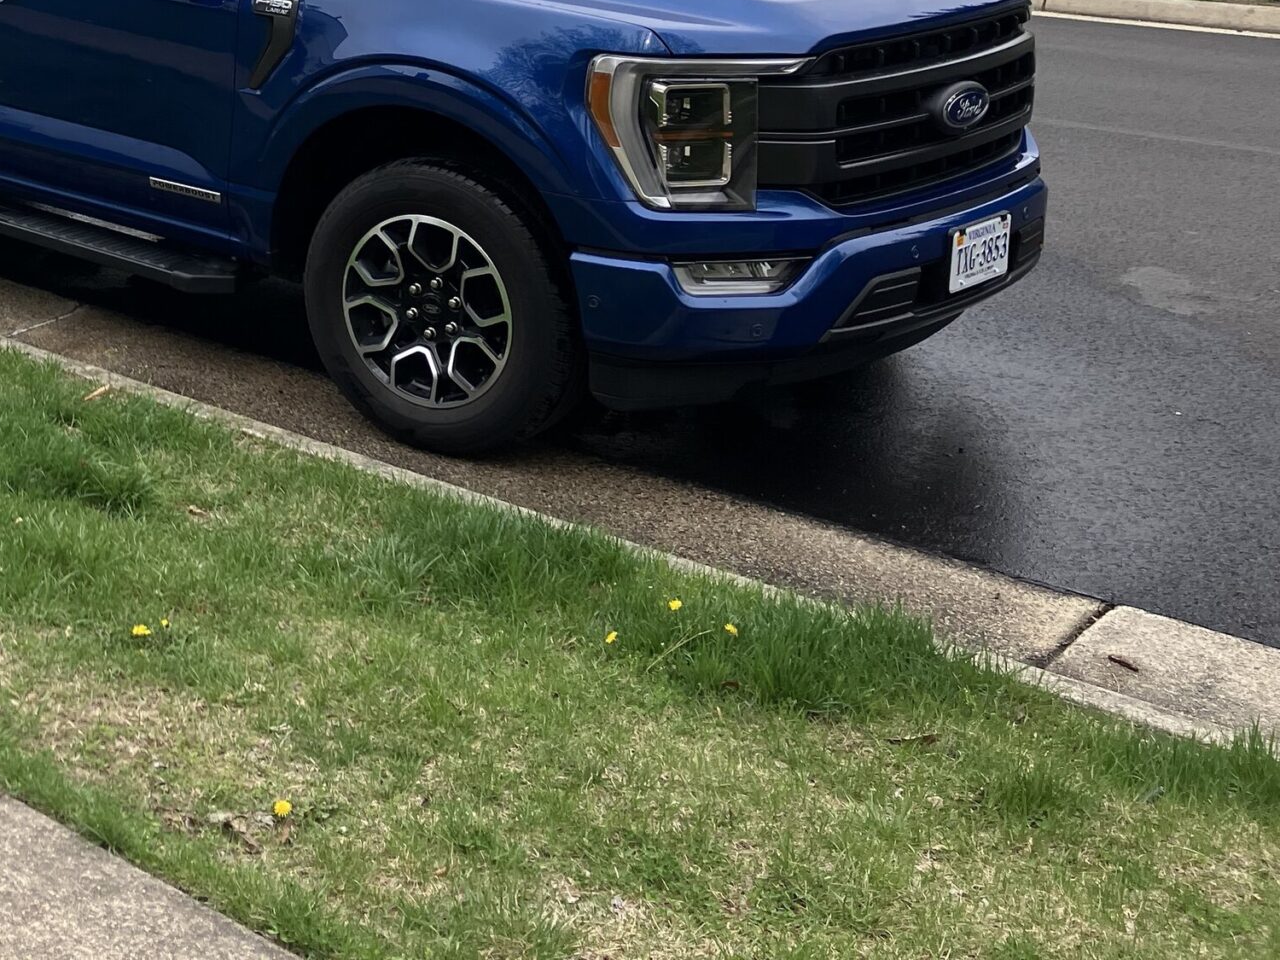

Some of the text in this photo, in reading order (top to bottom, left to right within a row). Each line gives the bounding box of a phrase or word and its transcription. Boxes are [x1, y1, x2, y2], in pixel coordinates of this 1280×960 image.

[152, 180, 217, 200] POWERBOOST
[968, 223, 997, 240] VIRGINIA
[956, 231, 1008, 276] TXG-3853
